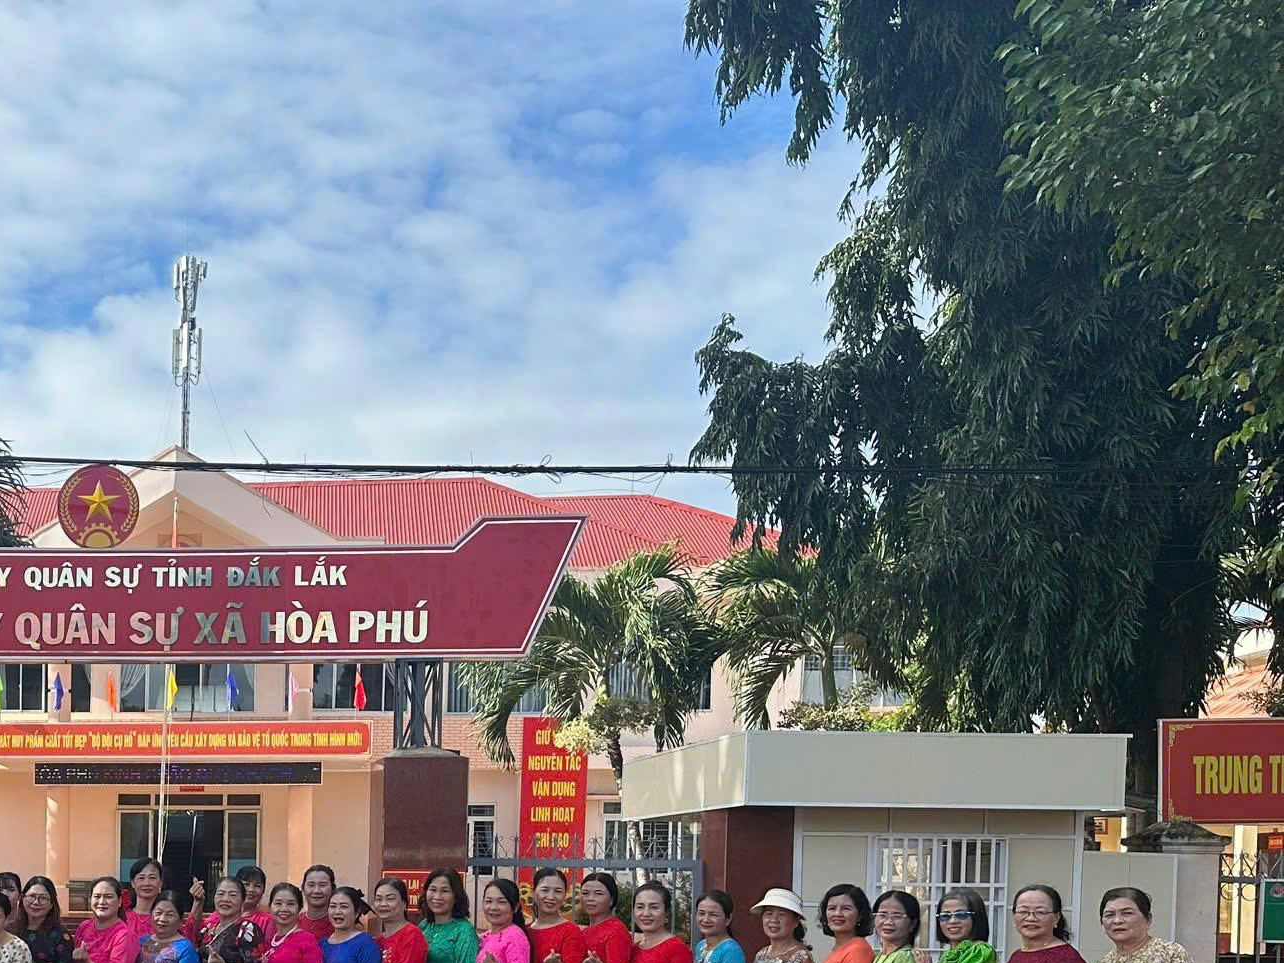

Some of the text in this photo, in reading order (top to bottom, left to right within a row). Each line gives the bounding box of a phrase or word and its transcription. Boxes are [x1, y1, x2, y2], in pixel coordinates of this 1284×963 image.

[23, 561, 93, 591] QUÂN
[104, 563, 143, 594] SỰ
[151, 558, 213, 587] TỈNH
[226, 556, 281, 587] ĐẮK
[294, 555, 347, 586] LẮK
[14, 603, 116, 650] QUÂN
[128, 606, 184, 651] SỰ
[193, 601, 247, 644] XÃ
[259, 600, 338, 644] HÒA
[348, 600, 429, 644] PHÚ
[528, 752, 563, 771] NGUYÊN
[1192, 754, 1263, 795] TRUNG
[532, 778, 576, 799] VẬN DỤNG
[531, 807, 575, 825] LINH HOẠT
